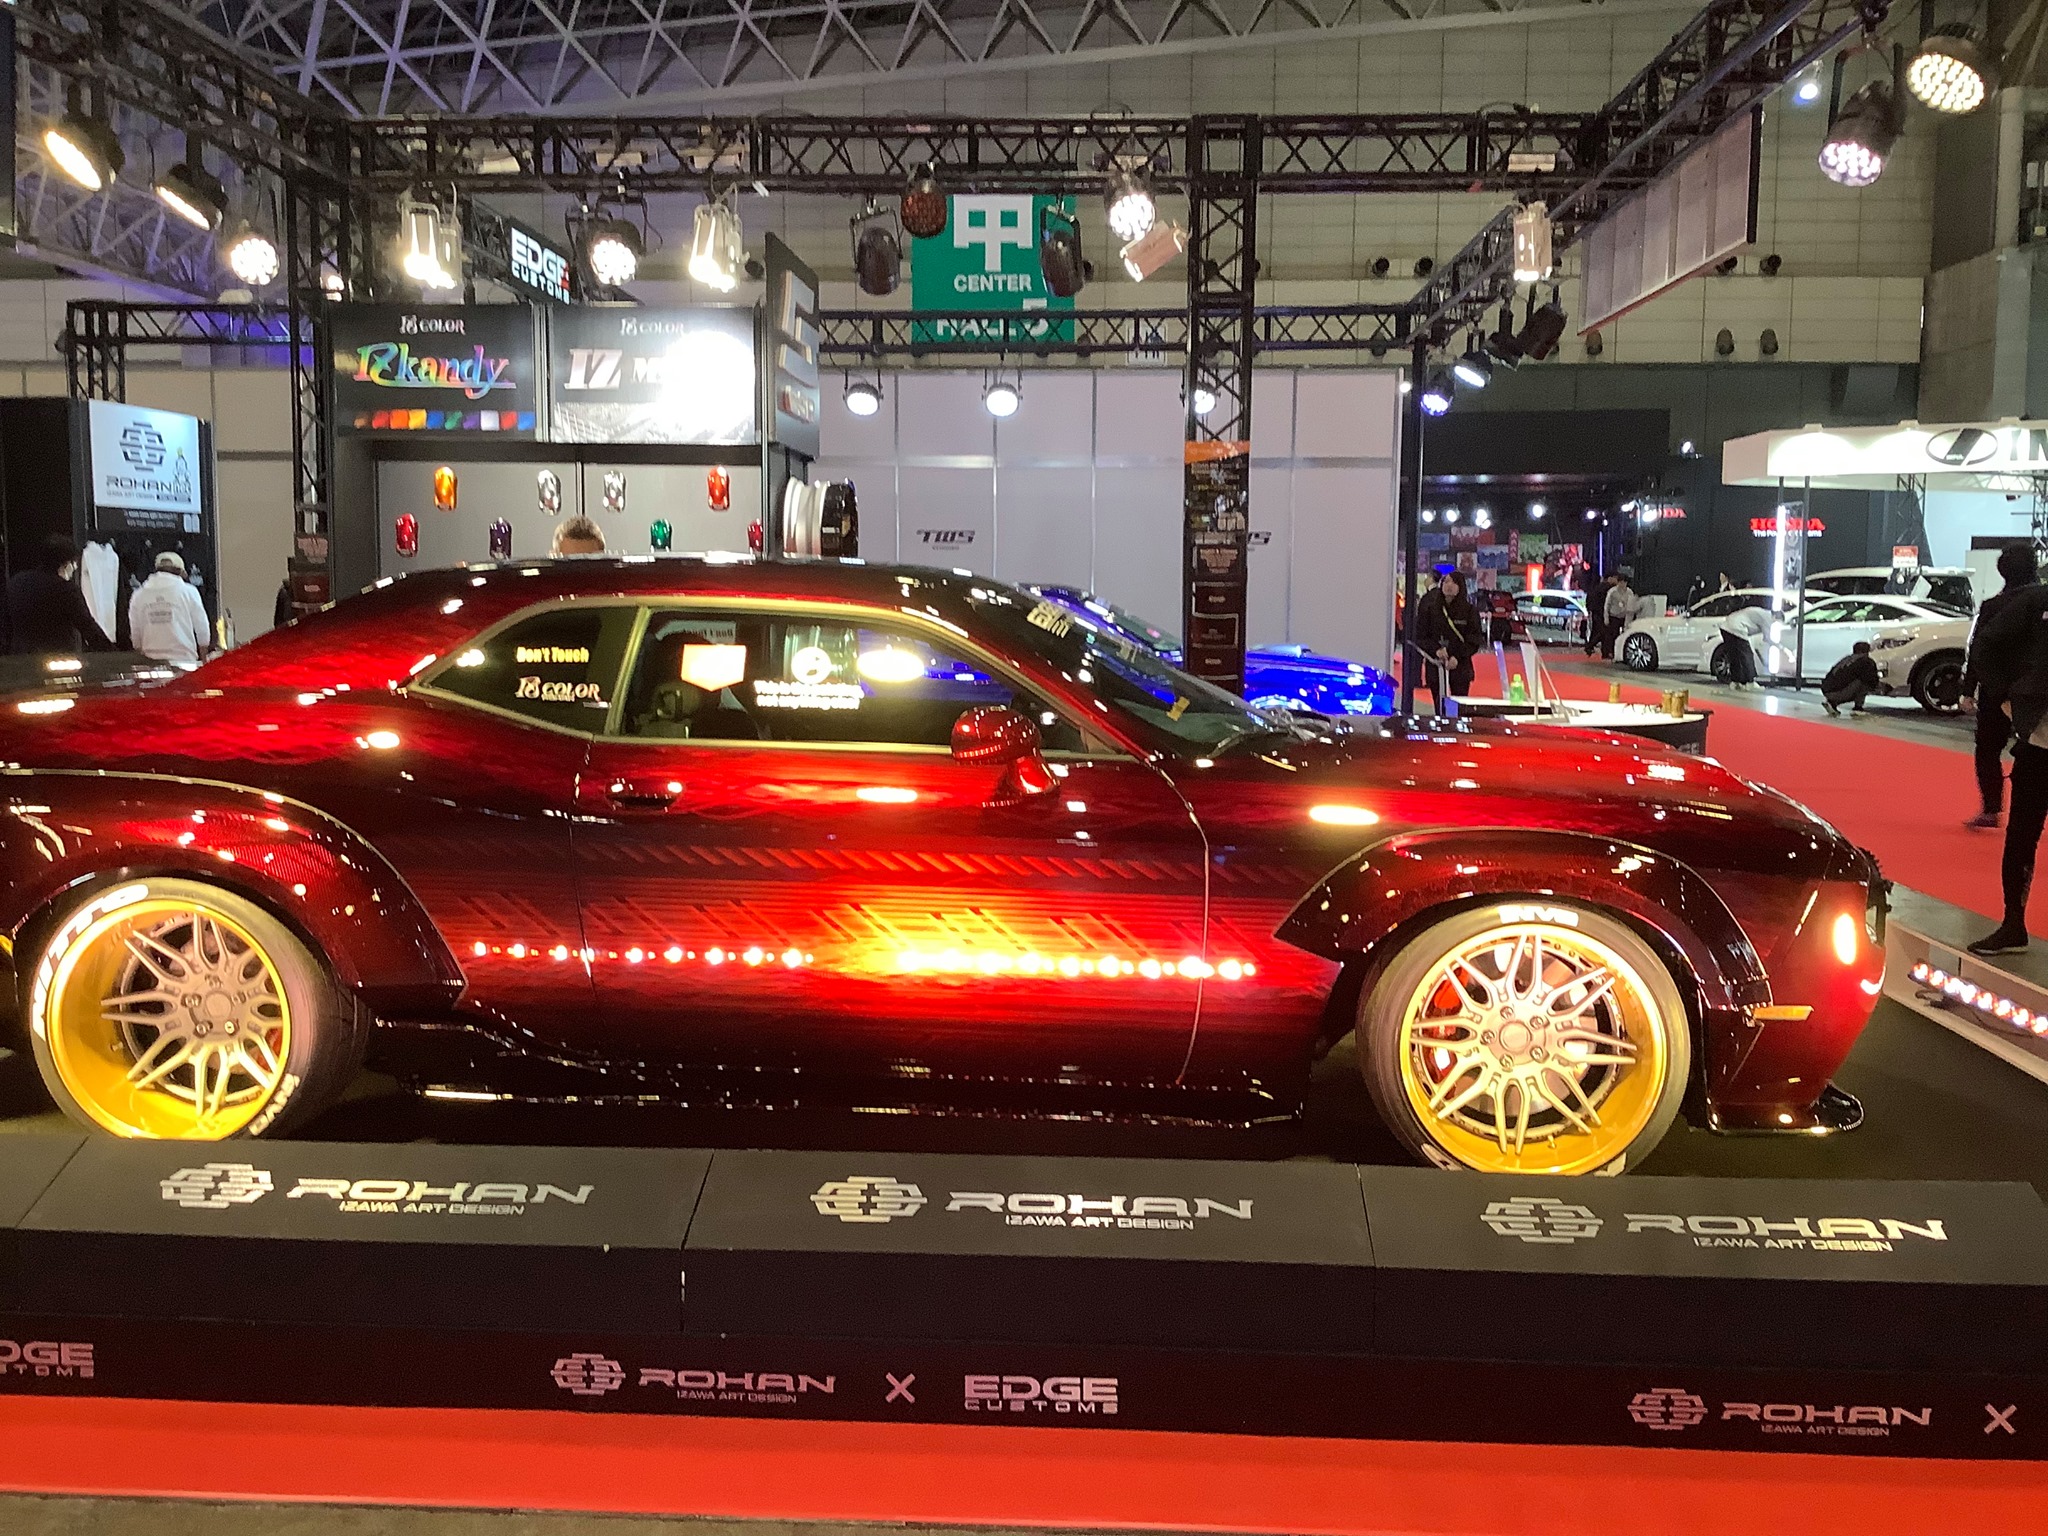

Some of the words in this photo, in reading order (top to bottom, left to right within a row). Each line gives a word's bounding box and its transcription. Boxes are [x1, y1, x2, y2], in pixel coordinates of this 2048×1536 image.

[953, 273, 1032, 293] CENTER
[419, 318, 466, 335] COLOR
[106, 475, 172, 493] ROHAN
[286, 1178, 594, 1203] ROHAN
[339, 1200, 399, 1213] IZAWA
[402, 1202, 446, 1214] ART
[448, 1203, 526, 1216] DESIGN
[945, 1191, 1253, 1219] ROHAN
[1004, 1214, 1066, 1228] IZAWA
[1070, 1216, 1114, 1229] ART
[1116, 1217, 1194, 1230] DESIGN
[1624, 1212, 1948, 1241] ROHAN
[1693, 1236, 1759, 1249] IZAWA
[1763, 1238, 1807, 1251] ART
[1810, 1239, 1894, 1253] DESIGN
[638, 1367, 836, 1393] ROHAN
[964, 1374, 1119, 1401] EDGE
[676, 1388, 716, 1401] IZAWA
[718, 1391, 746, 1402] ART
[748, 1392, 797, 1404] DESIGN
[1720, 1401, 1932, 1426] ROHAN
[1761, 1424, 1803, 1435] IZAWA
[1807, 1426, 1835, 1435] ART
[1837, 1427, 1890, 1437] DESIGN
